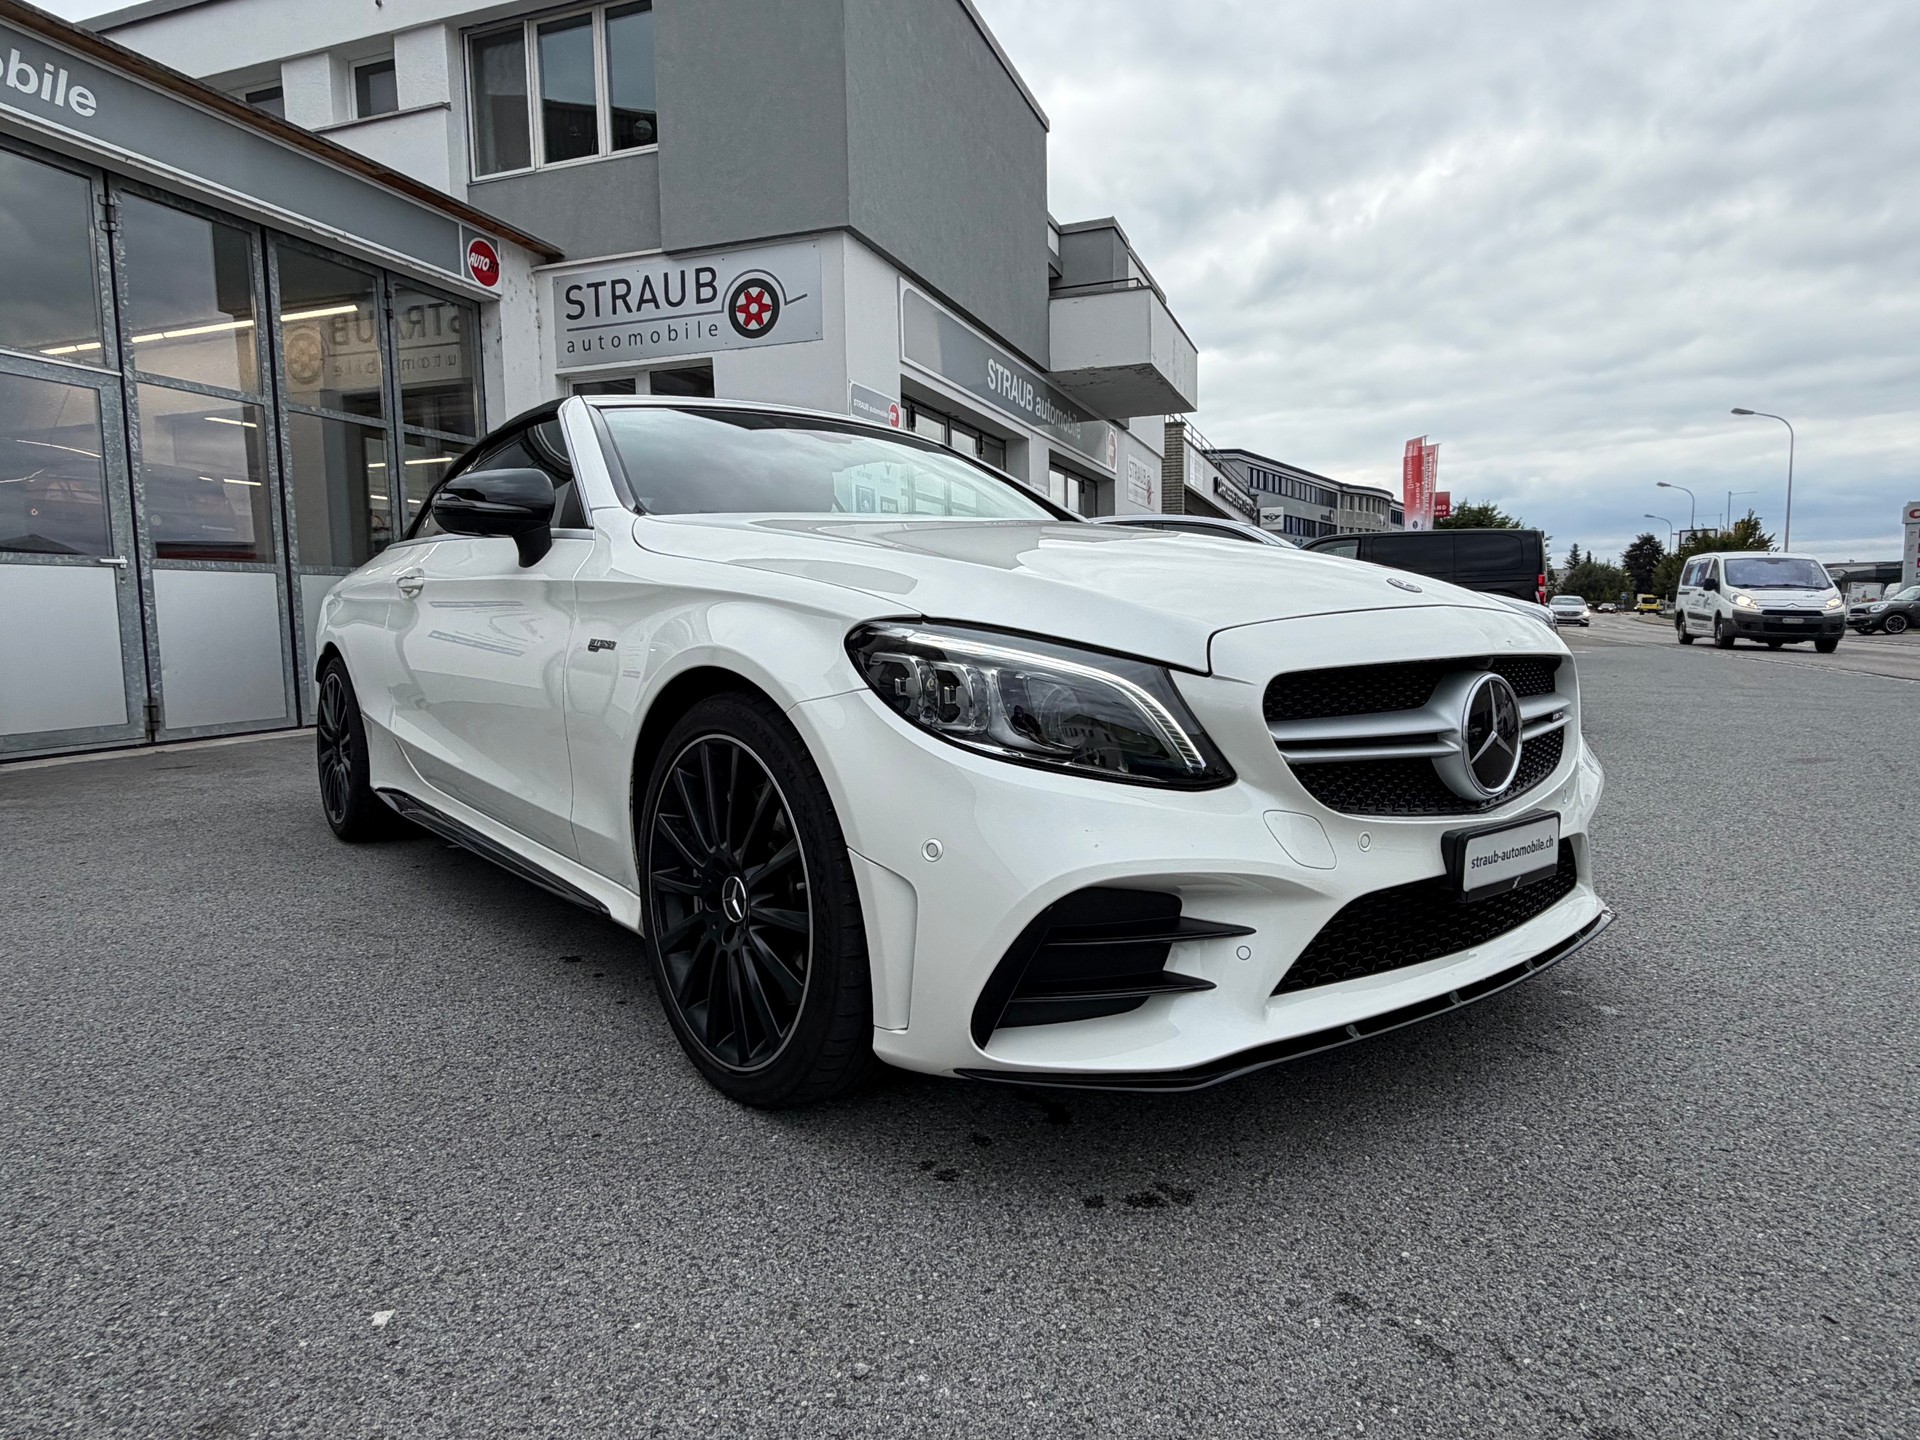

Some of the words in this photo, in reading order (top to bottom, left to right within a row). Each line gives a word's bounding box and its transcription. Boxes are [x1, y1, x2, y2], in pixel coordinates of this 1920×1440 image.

[0, 48, 97, 117] bile
[565, 266, 718, 321] STRAUB
[566, 320, 719, 353] automobile
[987, 358, 1034, 412] STRAUB
[1035, 396, 1081, 440] automobile
[1471, 835, 1553, 869] straub-automobile.ch
